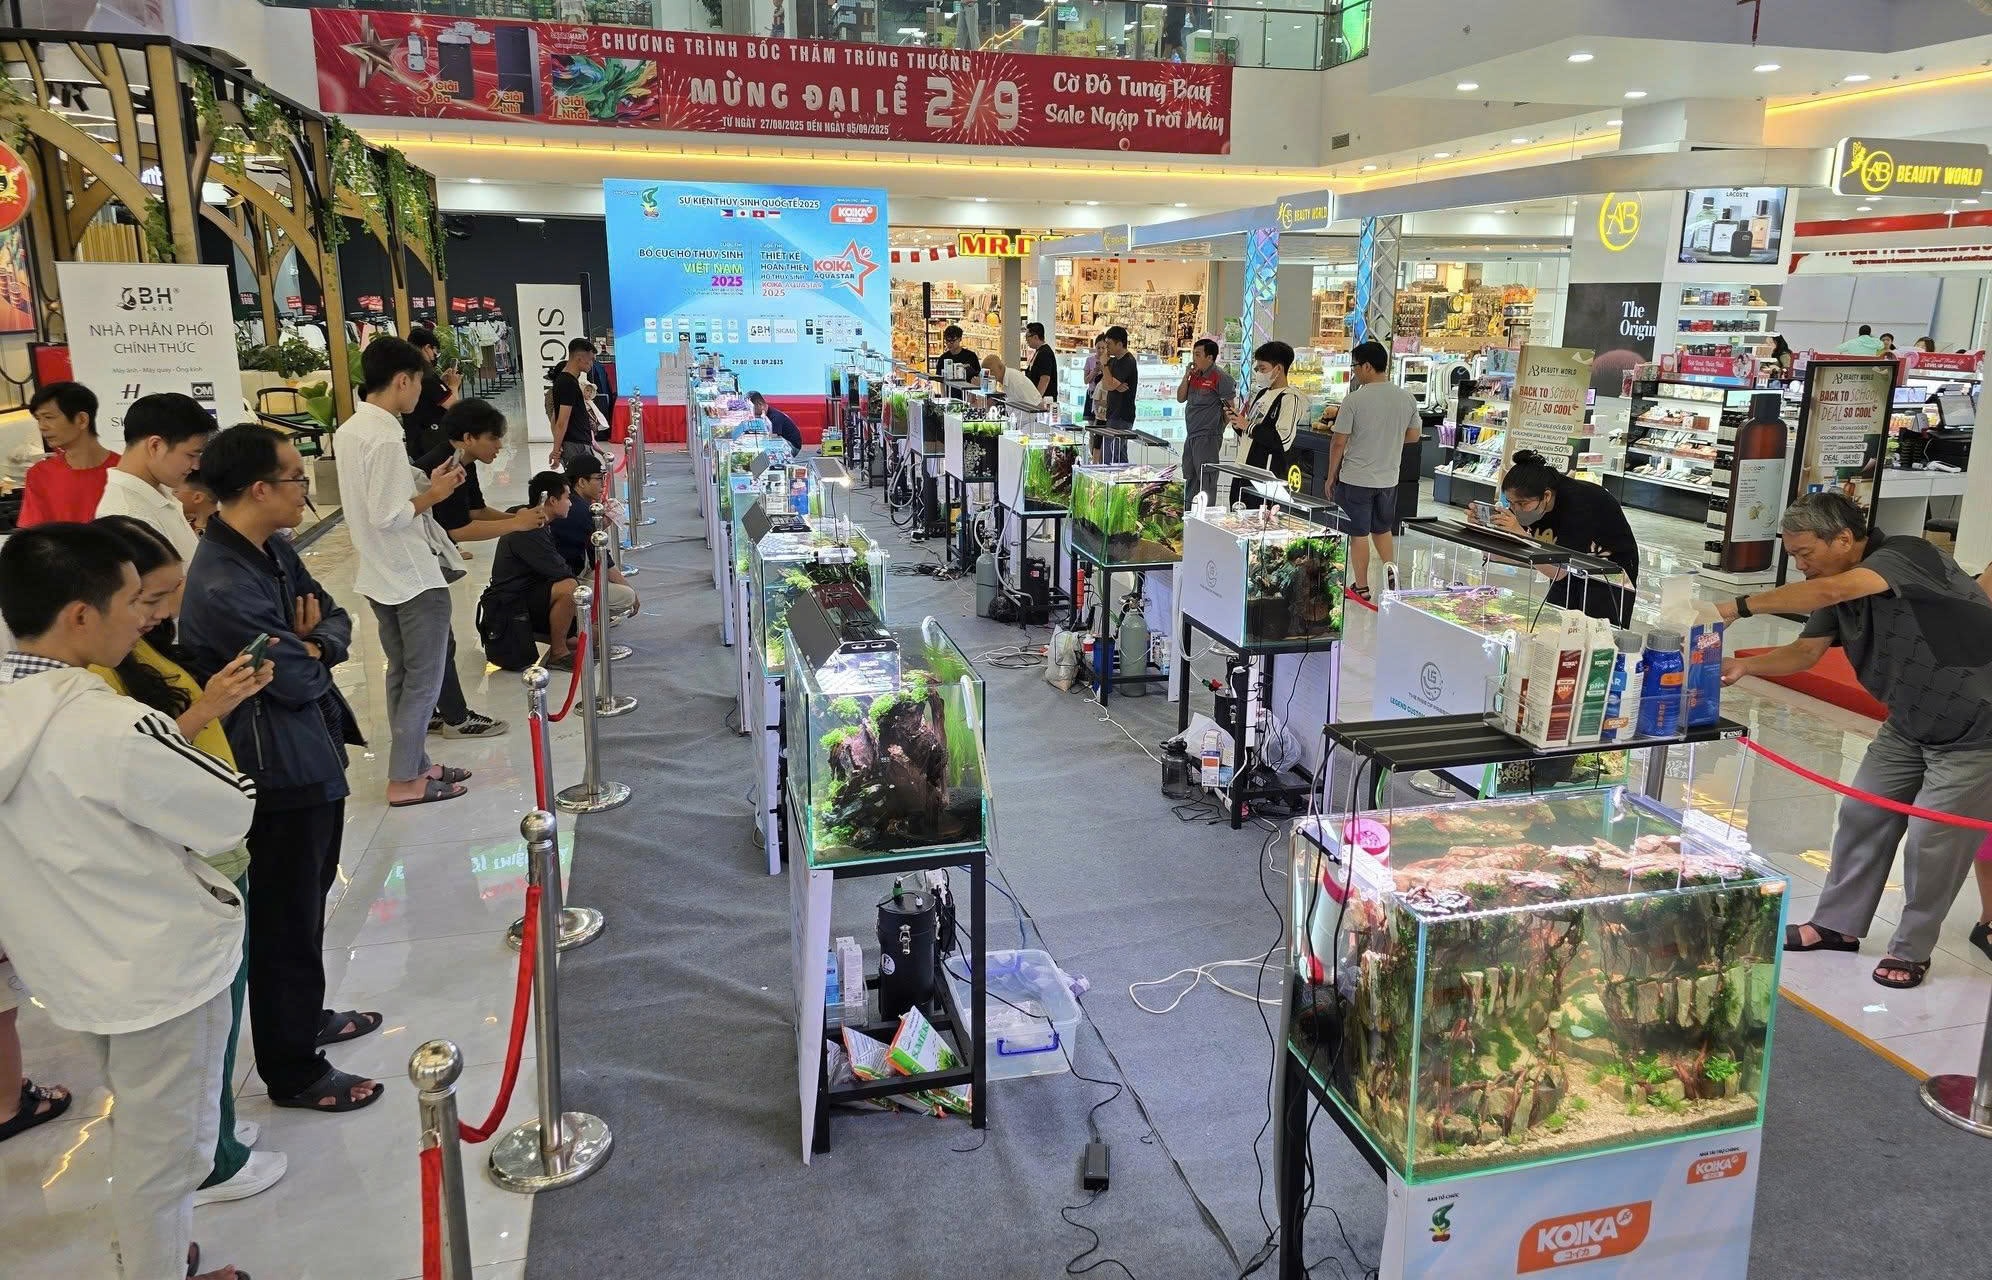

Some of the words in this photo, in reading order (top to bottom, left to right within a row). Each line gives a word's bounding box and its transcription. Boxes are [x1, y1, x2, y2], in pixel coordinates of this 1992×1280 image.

[602, 32, 675, 54] CHƯƠNG
[684, 36, 738, 58] TRÌNH
[747, 37, 780, 60] BỐC
[790, 43, 836, 65] THĂM
[844, 45, 899, 68] TRÚNG
[907, 50, 972, 73] THƯỞNG
[1053, 71, 1080, 93] Cờ
[1085, 73, 1112, 95] Đỏ
[1117, 75, 1167, 104] Tung
[1173, 78, 1213, 106] Bay
[690, 69, 788, 109] MỪNG
[802, 84, 860, 119] ĐẠI
[876, 75, 908, 116] LỄ
[926, 76, 1019, 132] 2/9
[1045, 103, 1085, 125] Sale
[1090, 106, 1139, 132] Ngập
[735, 115, 756, 129] NGÀY
[760, 119, 804, 131] 27/08/2025
[825, 120, 846, 133] NGÀY
[846, 124, 889, 135] 05/09/2025
[1896, 164, 1942, 184] BEAUTY
[1944, 167, 1984, 186] WORLD
[740, 199, 760, 207] SINH
[799, 200, 820, 208] 2025
[838, 207, 869, 218] KOIKA
[721, 250, 744, 259] SINH
[714, 263, 744, 274] NAM
[814, 260, 854, 272] KOIKA
[711, 276, 743, 287] 2025
[762, 289, 785, 297] 2025
[1621, 301, 1645, 318] The
[90, 322, 126, 336] NHÀ
[129, 322, 173, 336] PHÂN
[177, 321, 214, 336] PHỐI
[1620, 319, 1656, 341] Origin
[114, 342, 157, 354] CHÍNH
[160, 341, 196, 353] THỨC
[1540, 366, 1559, 375] BEAUTY
[1560, 367, 1577, 376] WORLD
[1520, 385, 1538, 397] BACK
[1540, 387, 1549, 398] TO
[1820, 390, 1838, 401] BACK
[1841, 390, 1849, 400] TO
[1542, 402, 1552, 414] SO
[1553, 404, 1572, 416] COOL
[1844, 407, 1853, 418] SO
[1855, 407, 1871, 418] COOL
[1554, 445, 1570, 453] 50%
[1696, 1158, 1732, 1175] KOIKA
[1537, 1216, 1618, 1252] KOIKA
